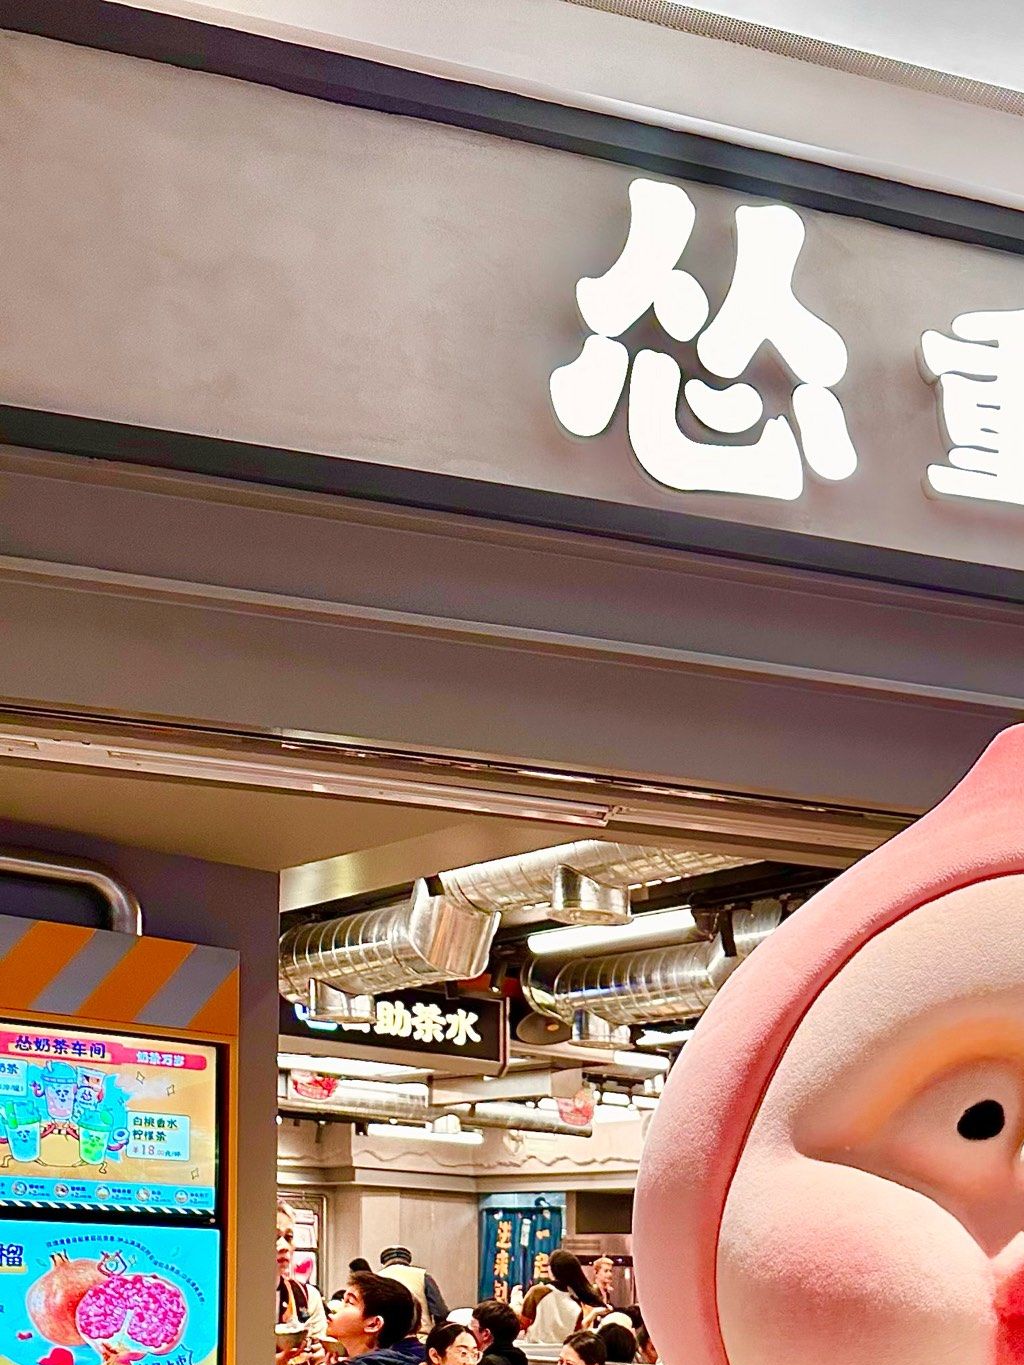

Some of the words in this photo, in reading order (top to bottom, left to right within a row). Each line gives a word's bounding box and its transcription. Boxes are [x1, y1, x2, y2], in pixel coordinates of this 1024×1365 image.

[342, 1000, 482, 1046] 助茶水
[15, 1035, 106, 1058] 怂奶茶车间
